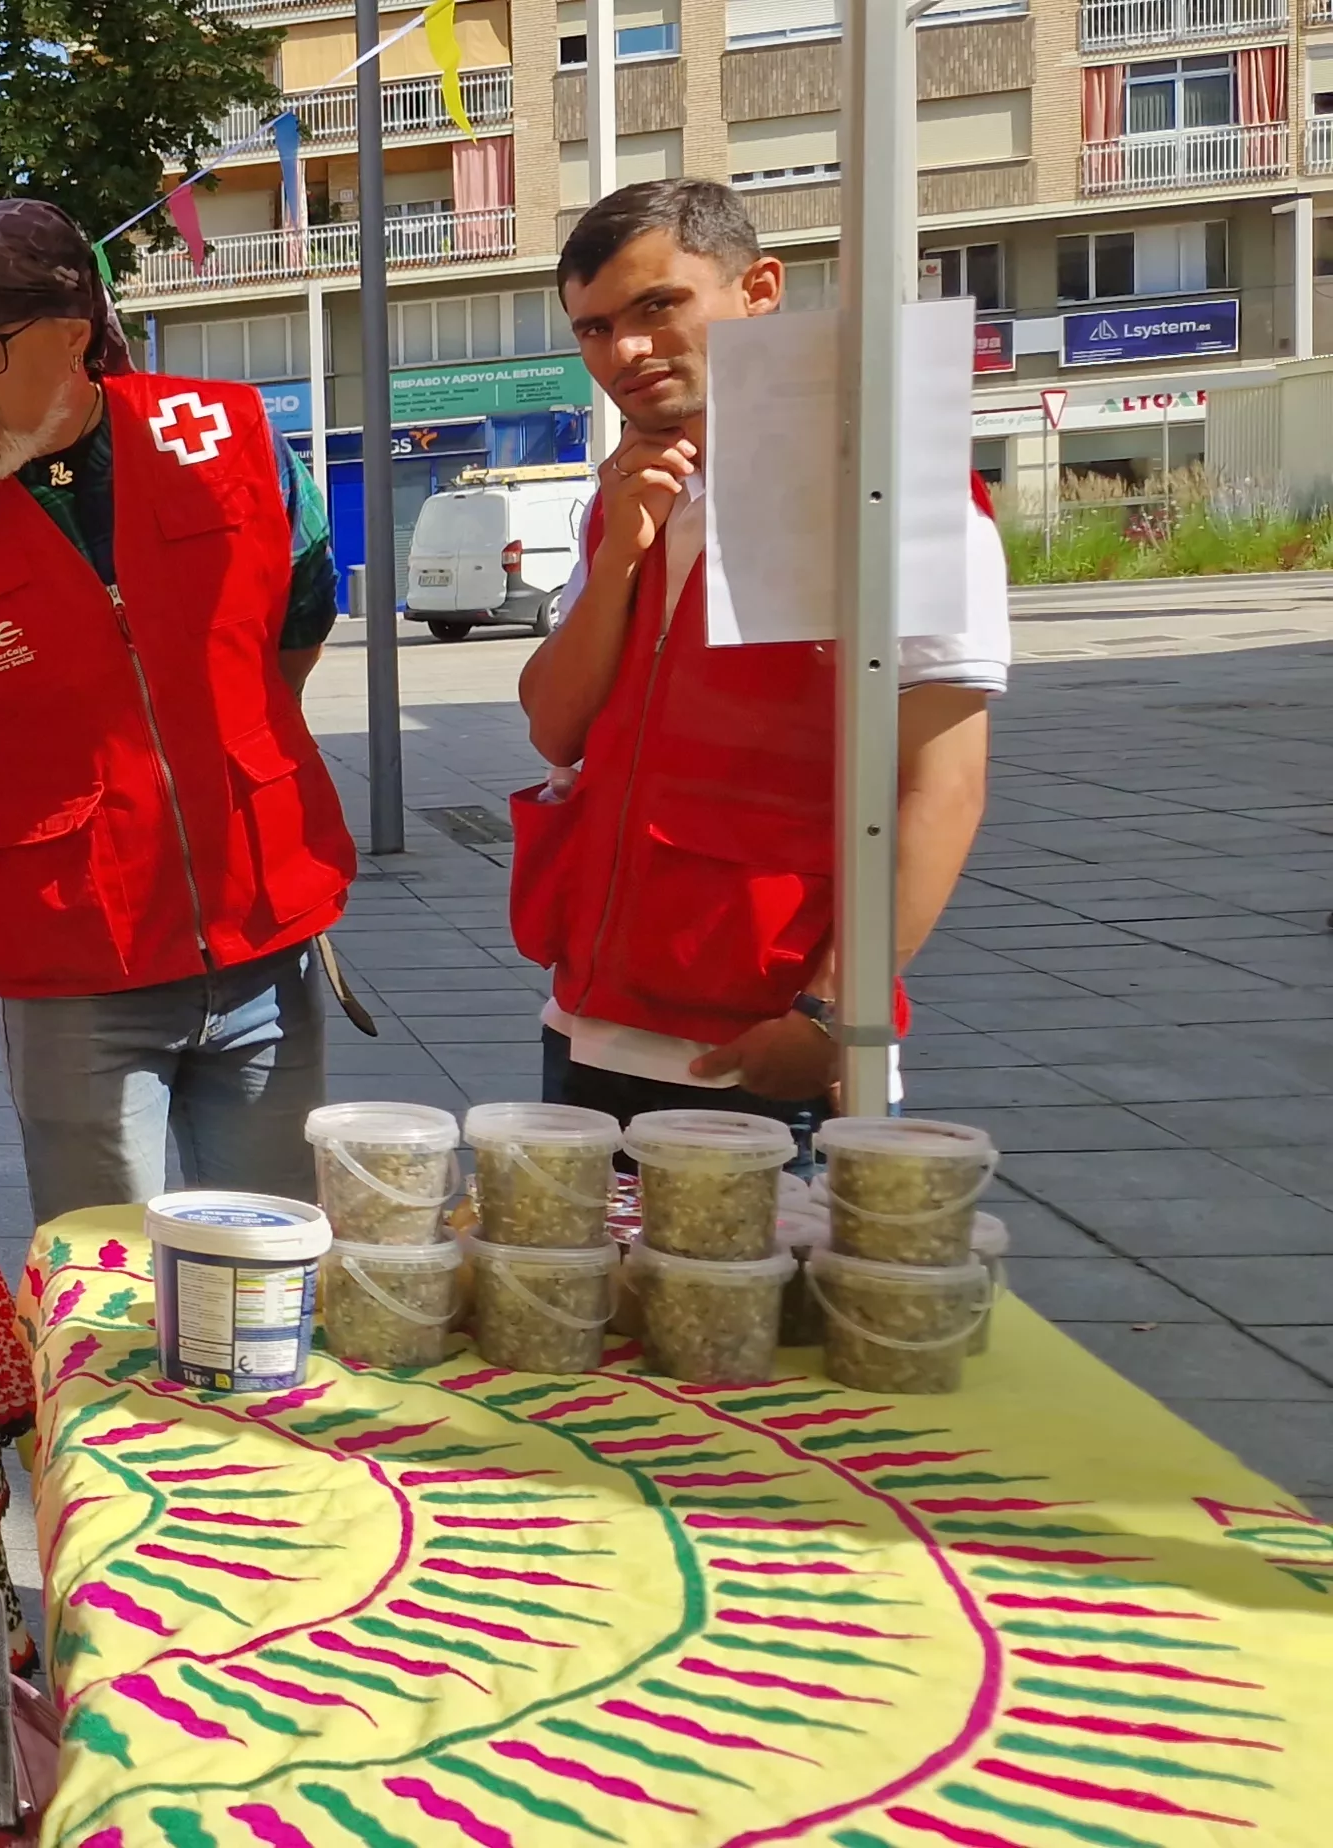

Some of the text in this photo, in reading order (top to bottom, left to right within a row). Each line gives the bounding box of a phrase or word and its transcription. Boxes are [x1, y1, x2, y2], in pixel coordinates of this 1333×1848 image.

[1123, 321, 1211, 339] Lsystem.es
[393, 366, 565, 390] REPASO Y APOYO AL ESTUDIO
